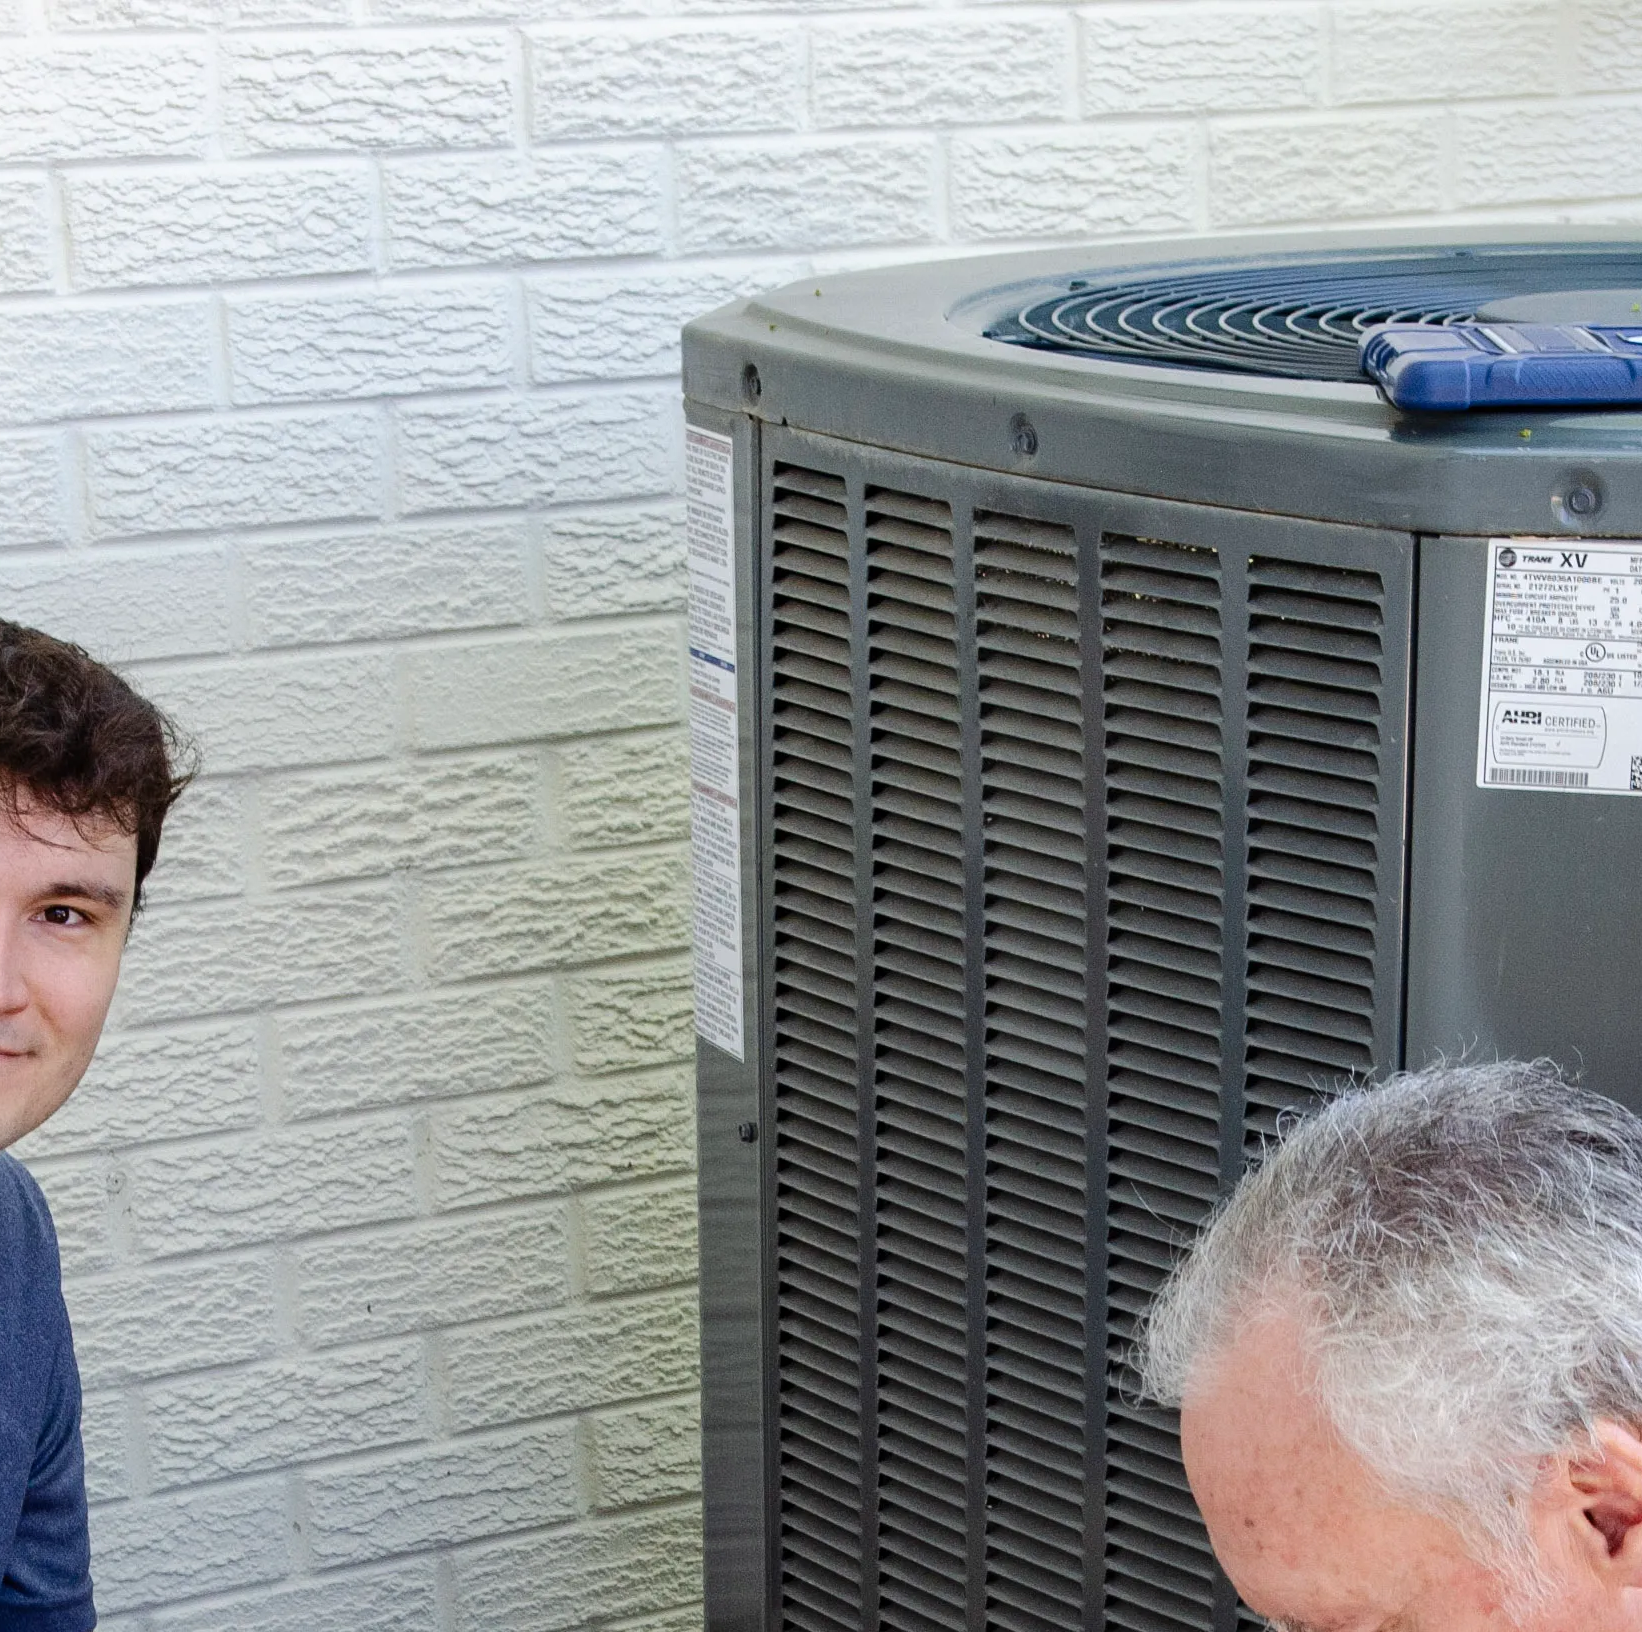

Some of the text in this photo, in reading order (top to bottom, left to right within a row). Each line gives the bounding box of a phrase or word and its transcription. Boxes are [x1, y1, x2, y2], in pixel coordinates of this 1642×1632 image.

[1522, 552, 1588, 569] TRANE XV
[1538, 602, 1574, 610] PROTECTIVE
[1501, 709, 1596, 729] AHRI CERTIFIED
